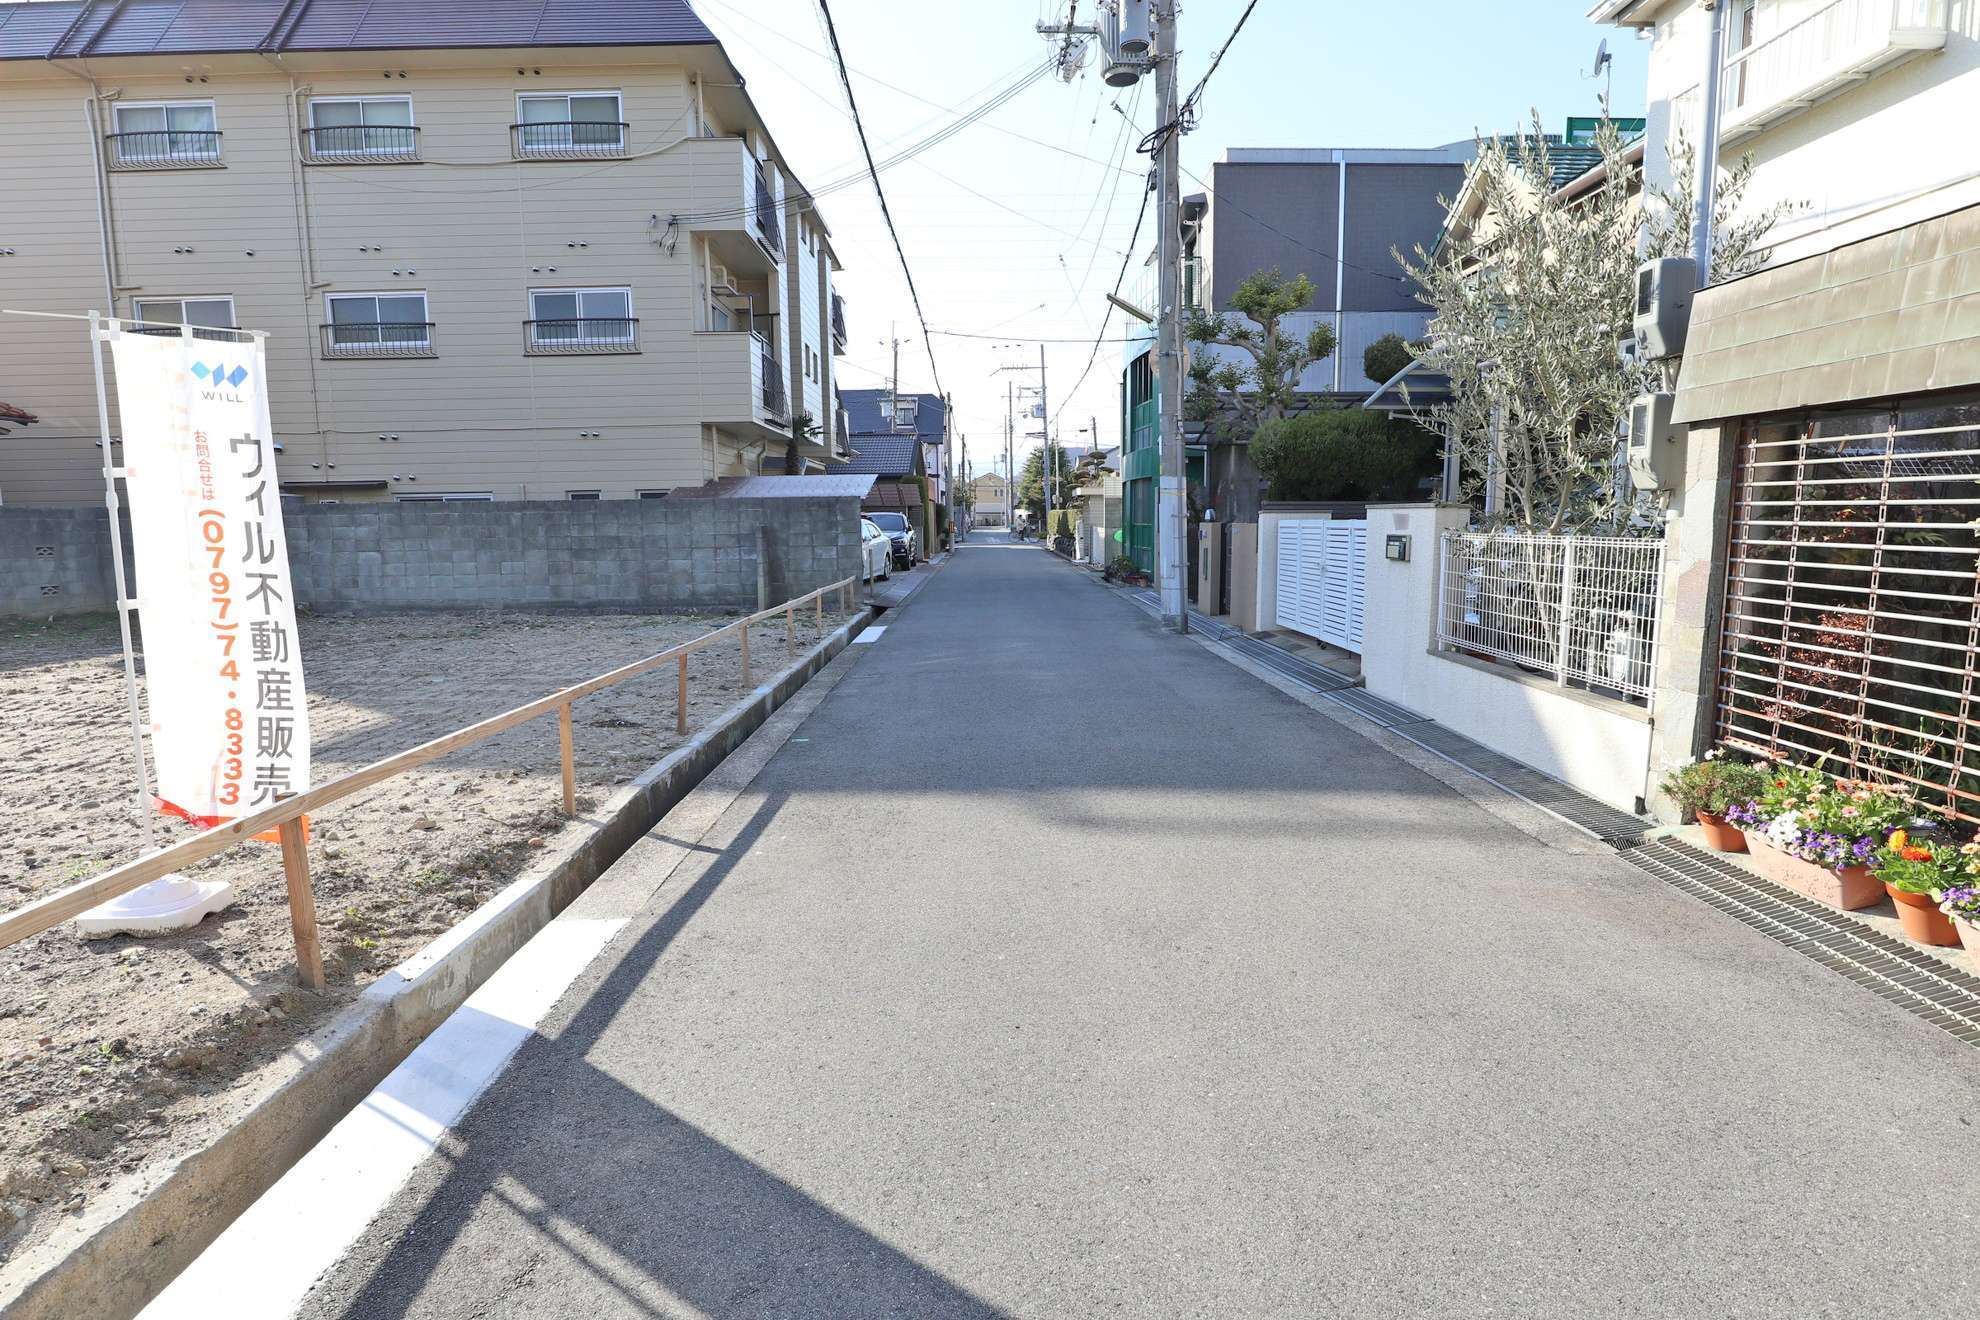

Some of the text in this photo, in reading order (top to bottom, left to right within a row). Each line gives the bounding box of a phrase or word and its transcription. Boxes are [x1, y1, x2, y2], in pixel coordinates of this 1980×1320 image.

[201, 391, 246, 403] WILL
[194, 429, 216, 501] お問合せは
[229, 433, 298, 807] ウィル不動産販売
